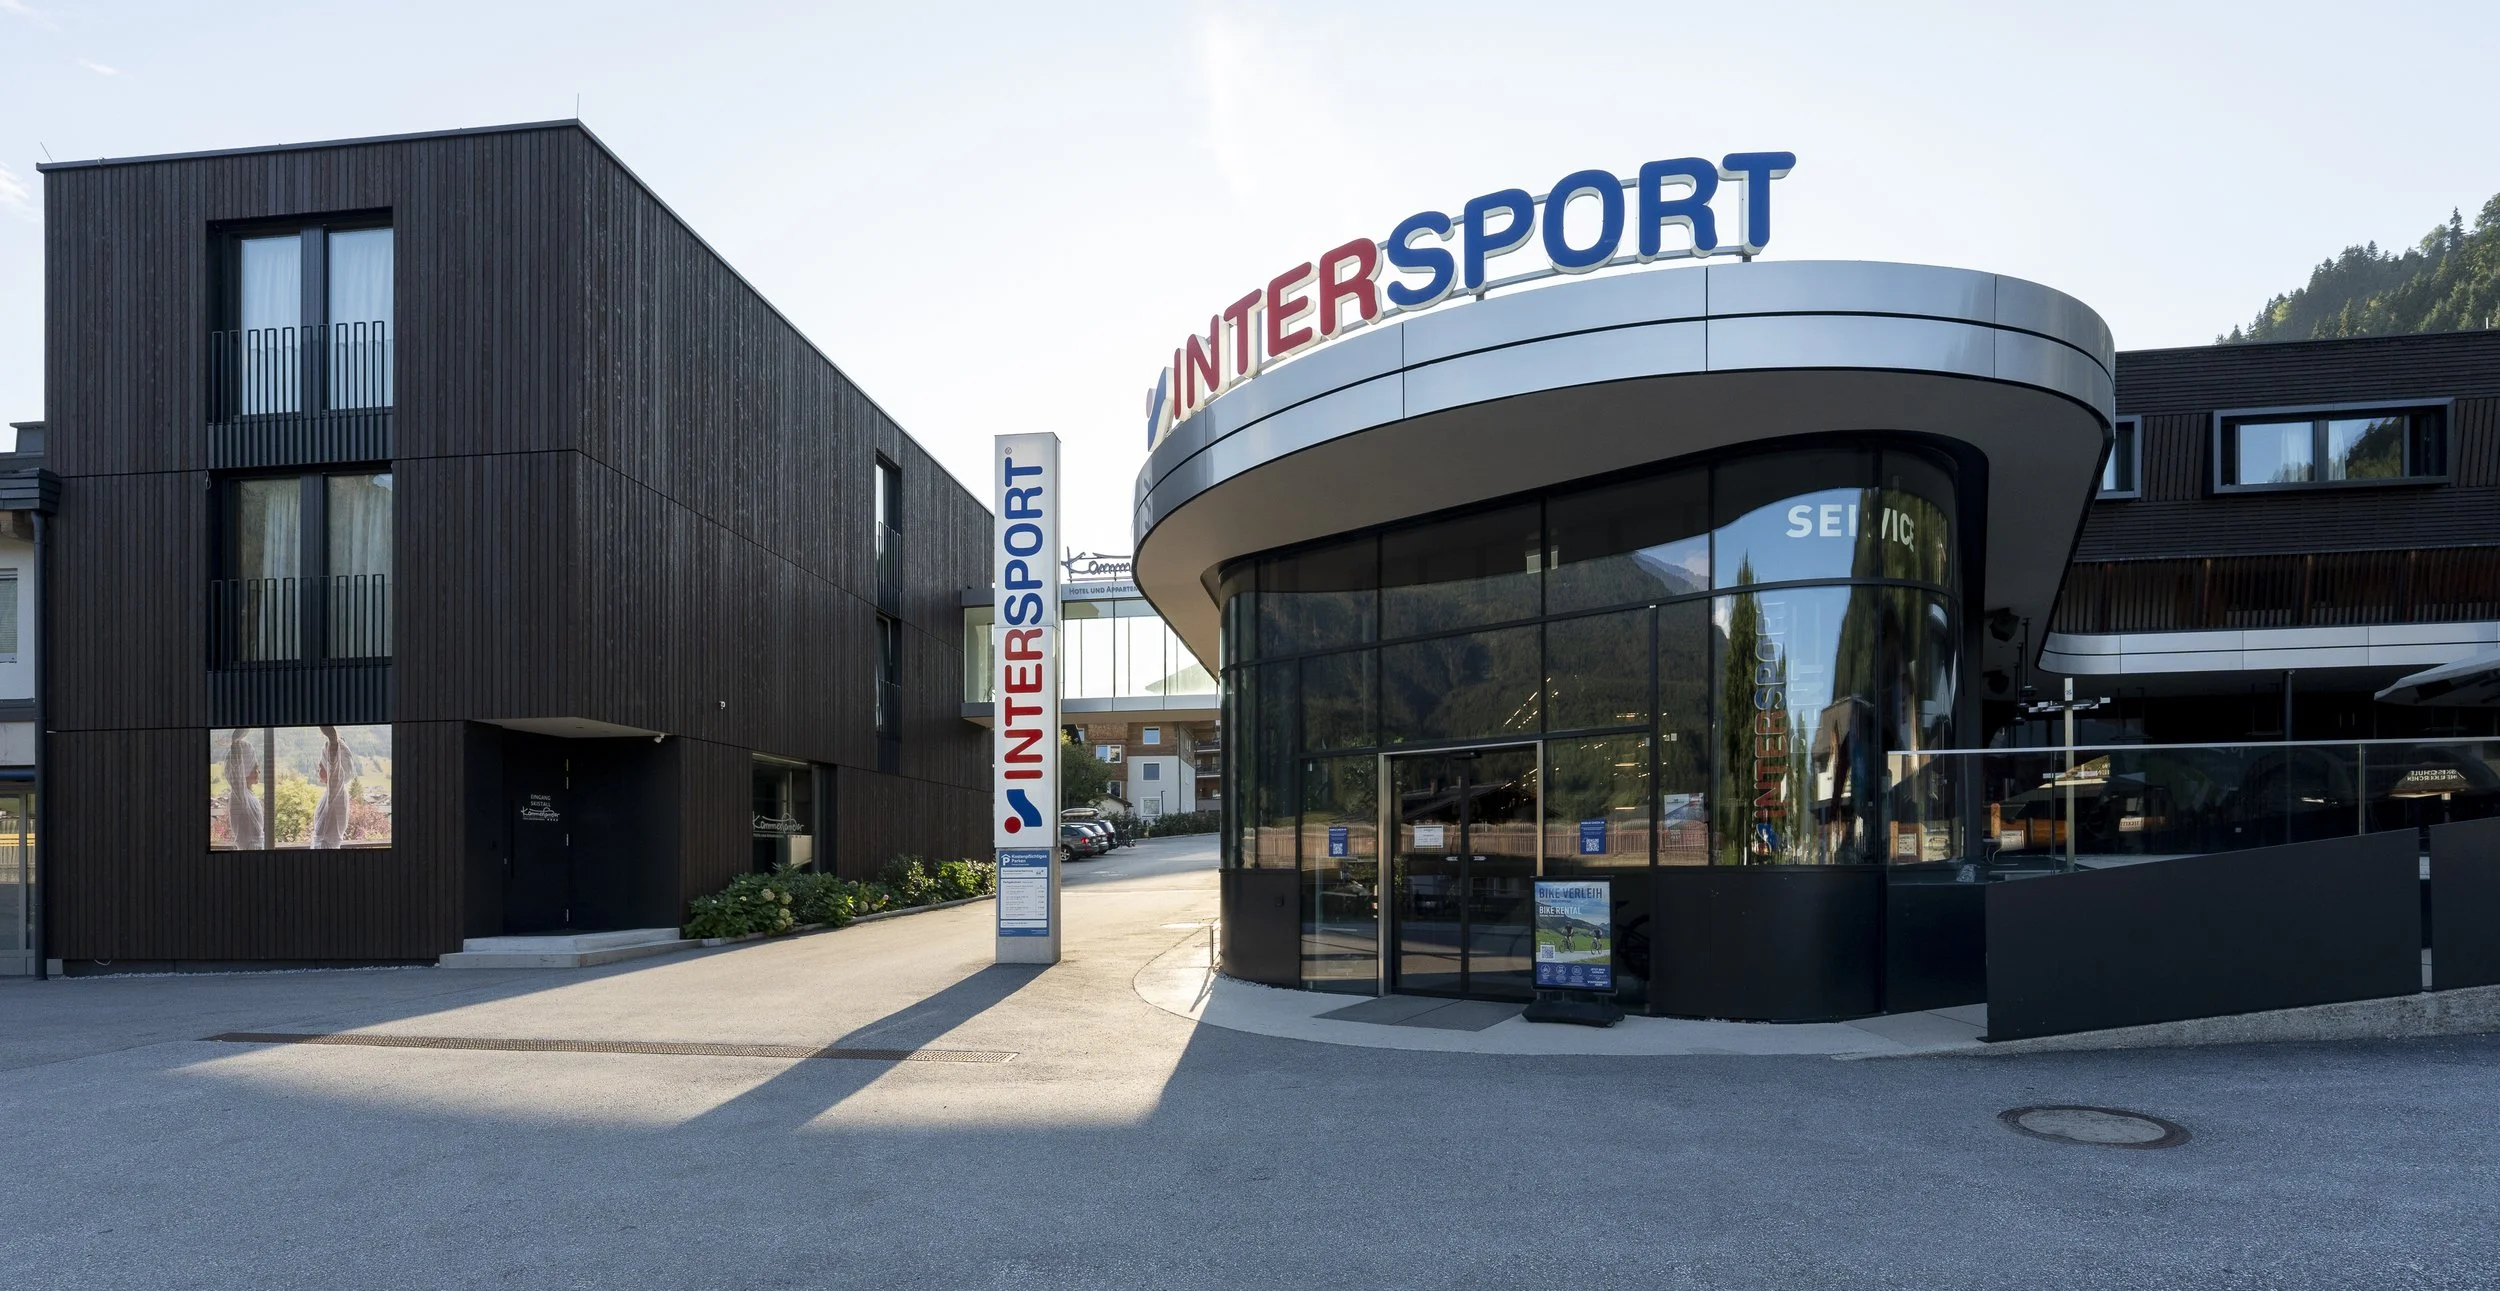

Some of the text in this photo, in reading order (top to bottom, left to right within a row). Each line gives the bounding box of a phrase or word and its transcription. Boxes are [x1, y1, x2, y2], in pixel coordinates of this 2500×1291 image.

[1174, 151, 1797, 421] INTERSPORT
[1004, 456, 1044, 780] INTERSPORT
[1753, 591, 1788, 819] INTERSPORT
[1539, 888, 1602, 899] BIKE VERLEIH
[1540, 906, 1582, 915] BIKE RENTAL
